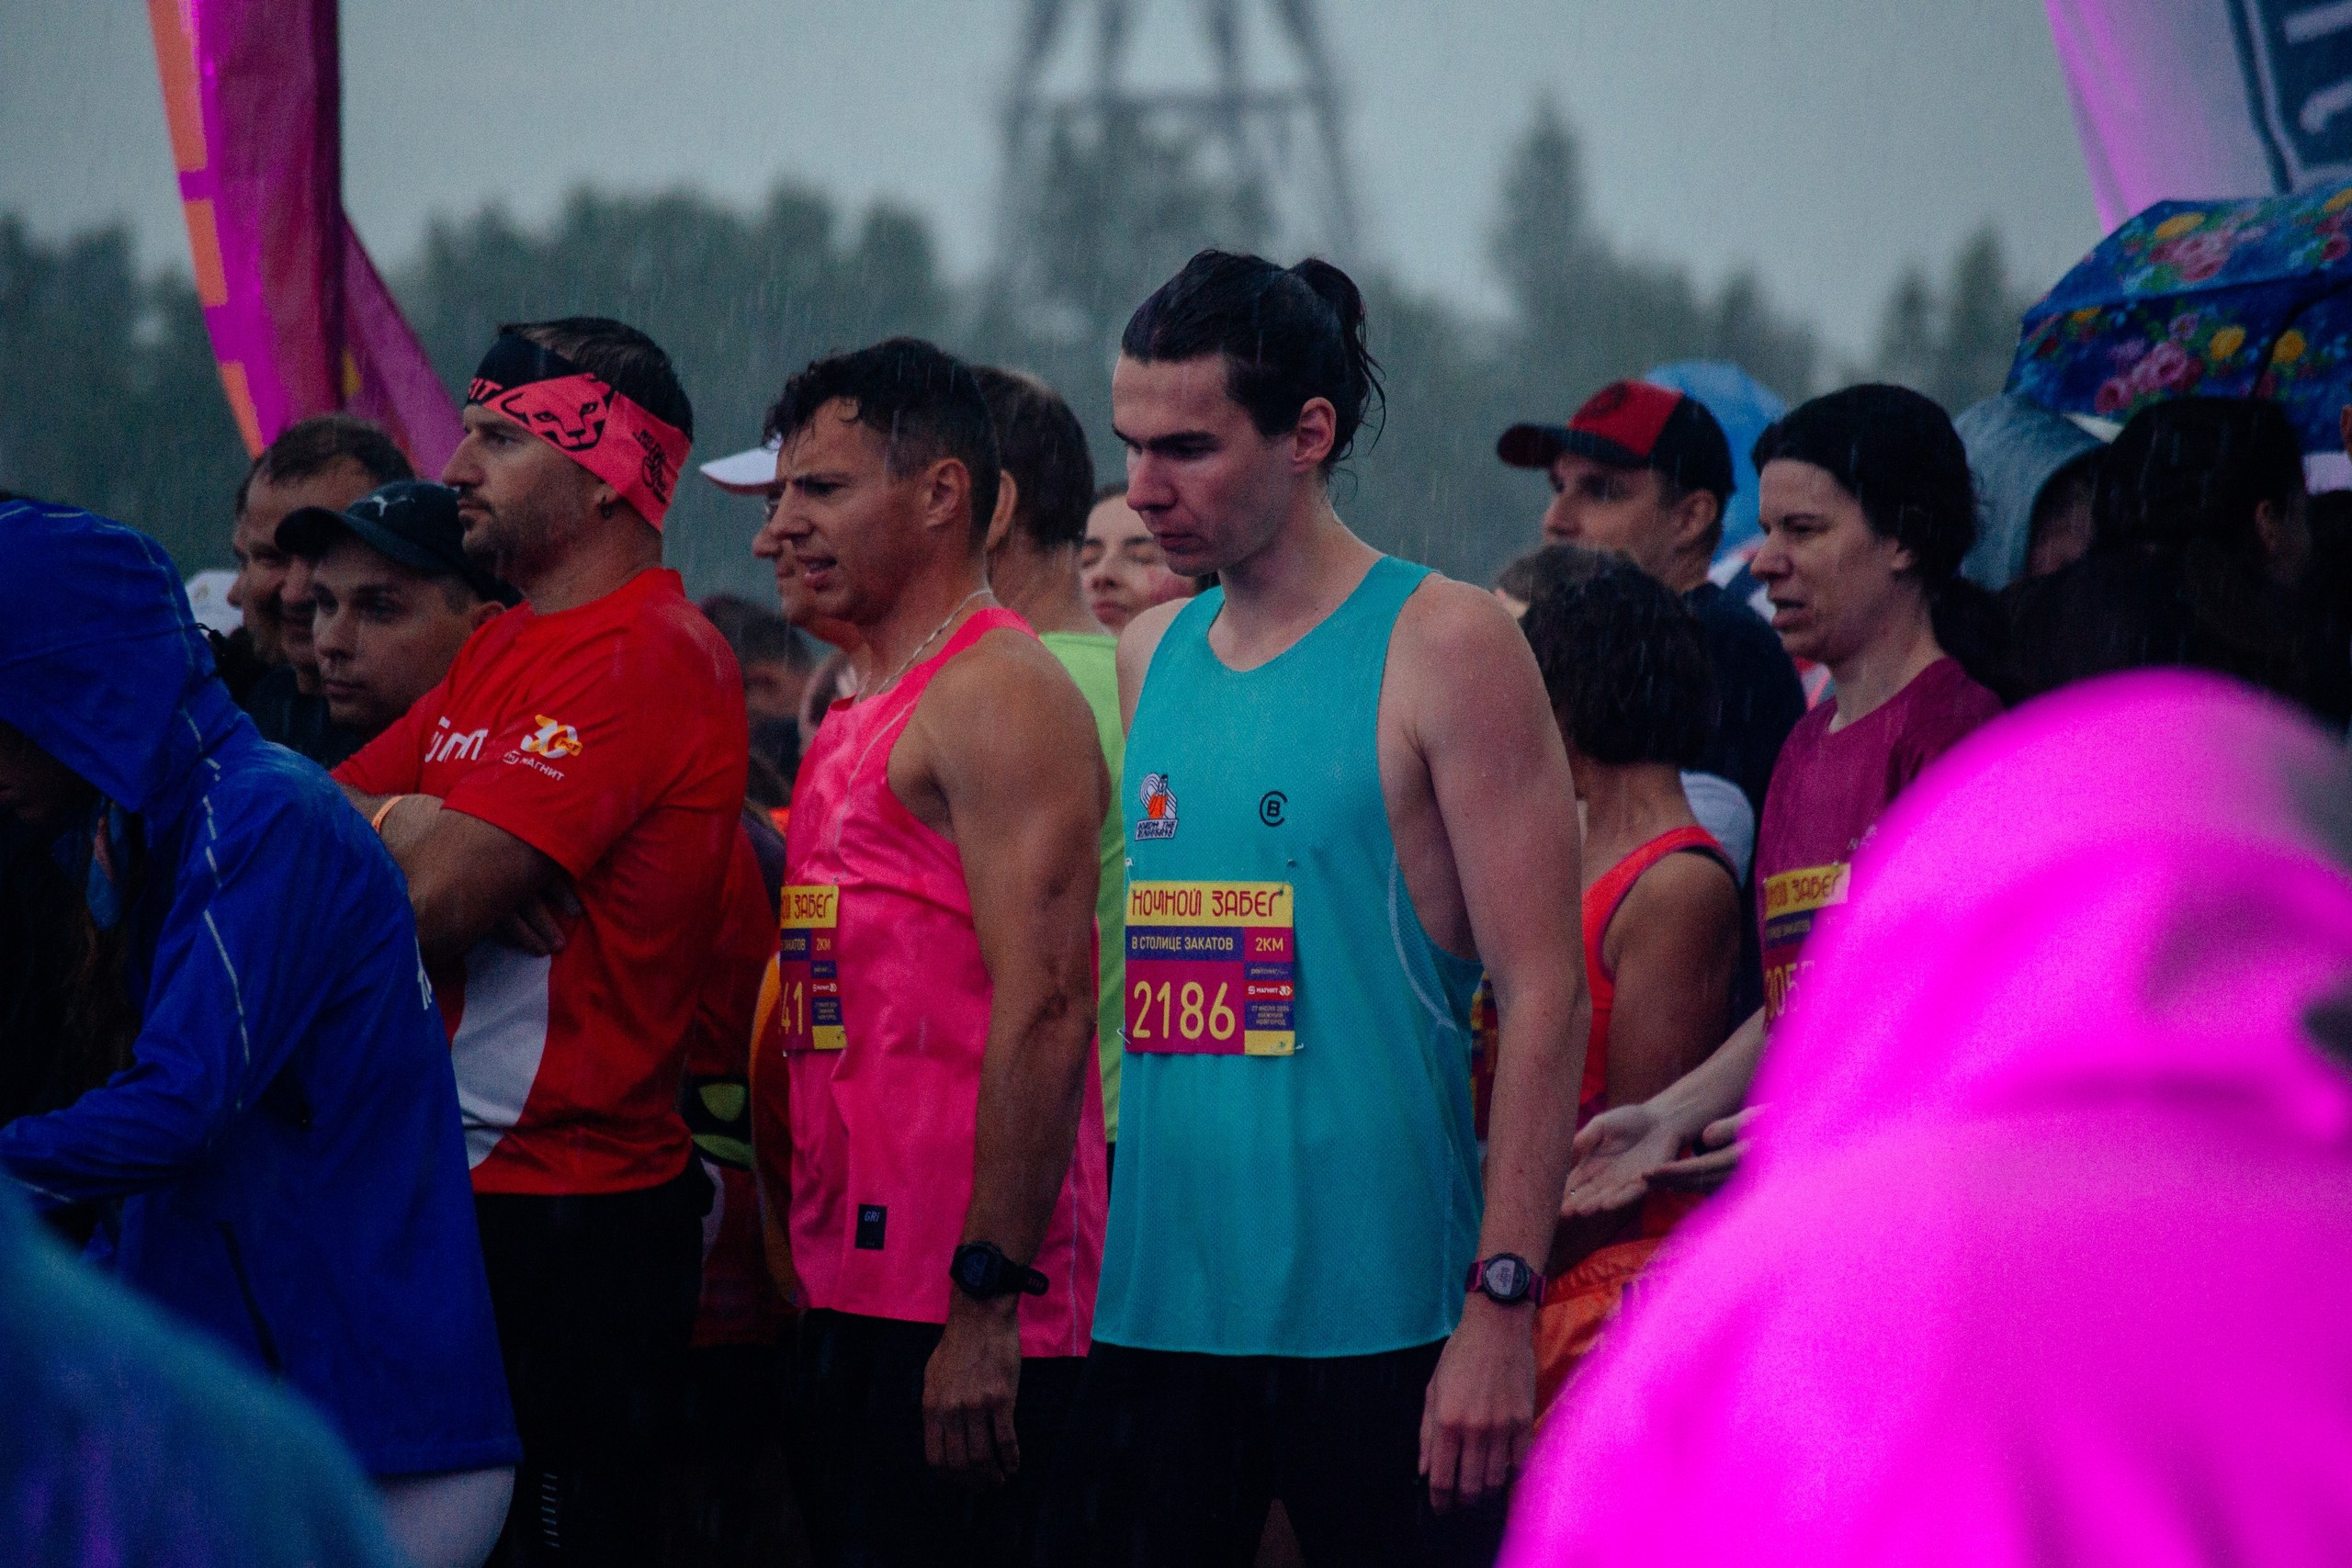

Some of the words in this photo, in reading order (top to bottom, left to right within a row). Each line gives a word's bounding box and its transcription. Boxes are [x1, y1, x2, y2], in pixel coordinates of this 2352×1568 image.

[795, 894, 833, 919] ЗАБЕГ
[1131, 888, 1202, 918] НОЧНОЙ
[1212, 890, 1280, 918] ЗАБЕГ
[1131, 936, 1138, 950] В
[1139, 936, 1182, 952] СТОЛИЦЕ
[1184, 936, 1234, 952] ЗАКАТОВ
[1132, 979, 1236, 1041] 2186
